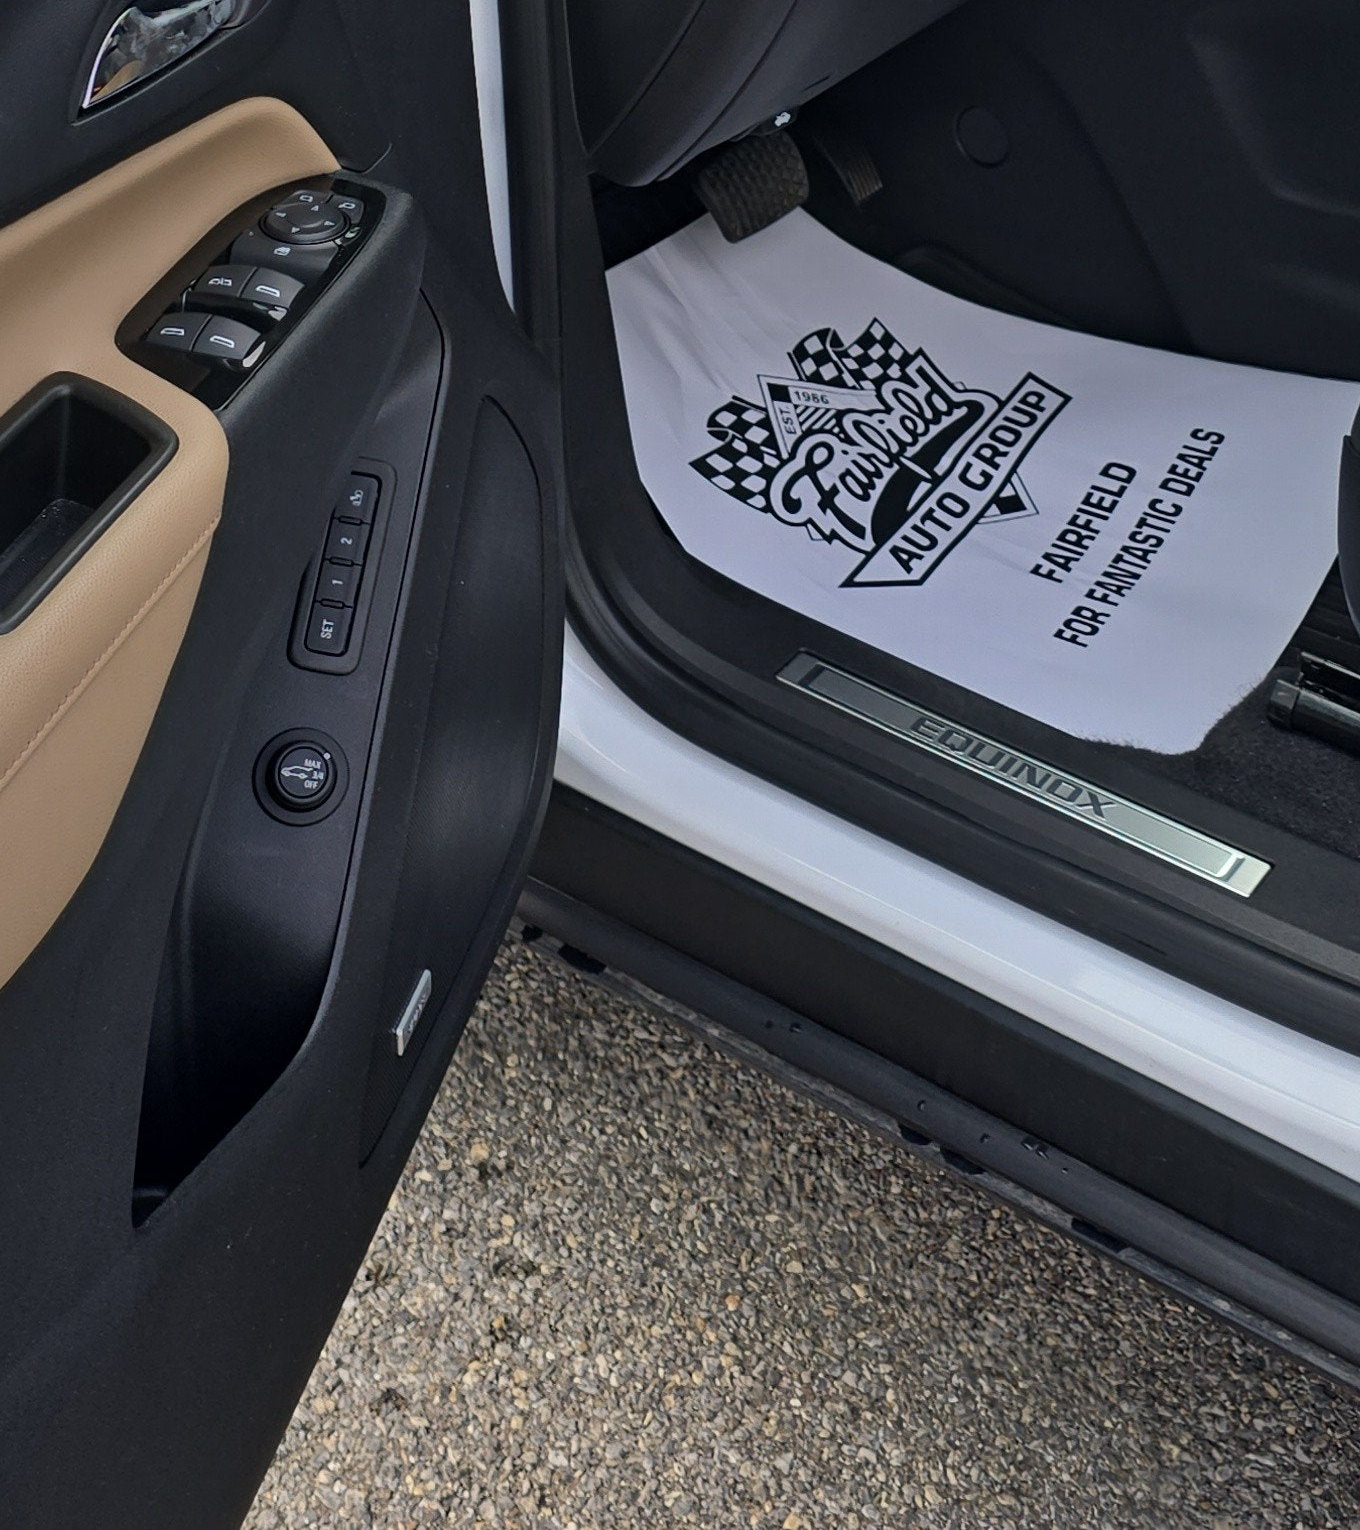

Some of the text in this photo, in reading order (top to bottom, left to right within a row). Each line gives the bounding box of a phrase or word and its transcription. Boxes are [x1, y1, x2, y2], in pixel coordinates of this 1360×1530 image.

[780, 363, 976, 545] Fairfield
[889, 389, 1047, 575] AUTO GROUP
[340, 537, 353, 545] 2
[1029, 461, 1138, 584] FAIRFIELD
[1052, 427, 1226, 649] FOR FANTASTIC DEALS
[331, 578, 344, 586] 1
[320, 618, 335, 640] SET
[303, 758, 321, 770] MAX
[303, 779, 319, 789] OFF
[909, 715, 1118, 821] EQUINOX
